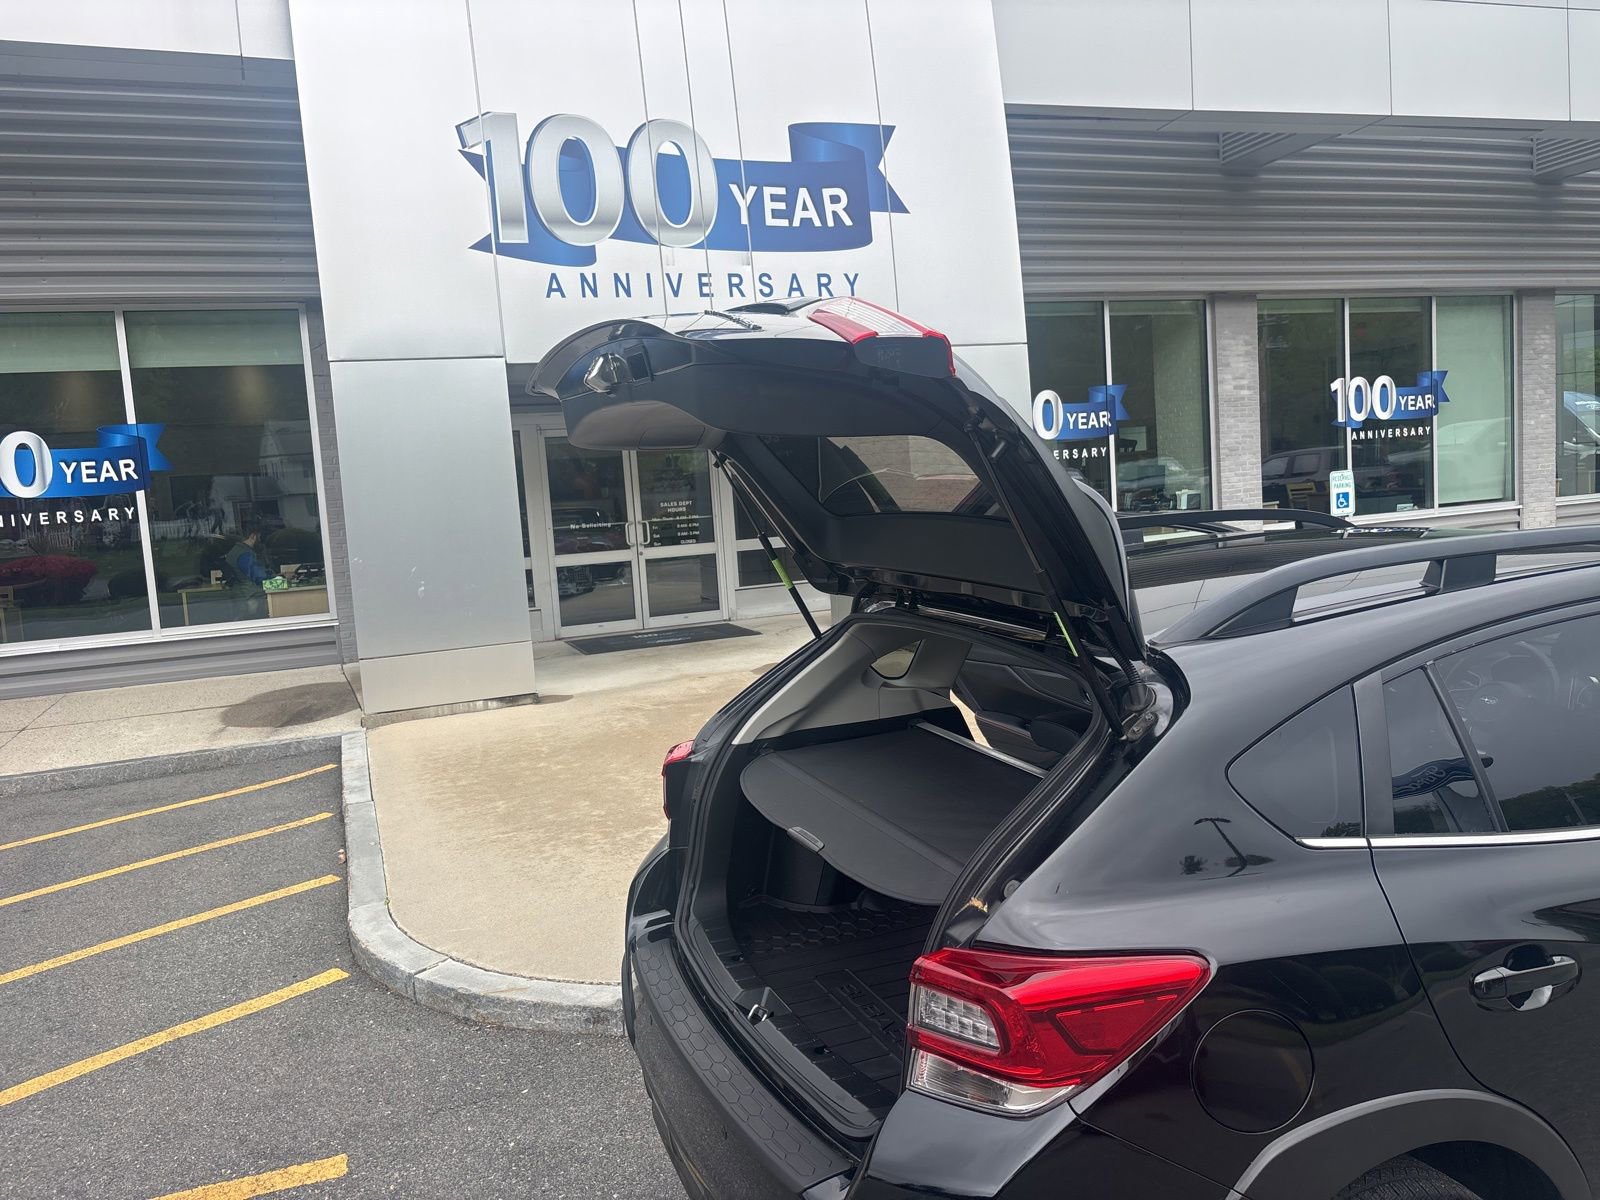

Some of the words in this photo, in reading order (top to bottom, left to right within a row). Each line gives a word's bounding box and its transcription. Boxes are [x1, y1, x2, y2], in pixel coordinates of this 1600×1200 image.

[455, 111, 719, 249] 100
[728, 183, 854, 228] YEAR
[545, 272, 861, 299] ANNIVERSARY
[1330, 375, 1397, 422] 100
[1399, 394, 1436, 411] YEAR
[1066, 411, 1111, 430] YEAR
[1352, 426, 1431, 440] ANNIVERSARY
[59, 459, 139, 484] YEAR
